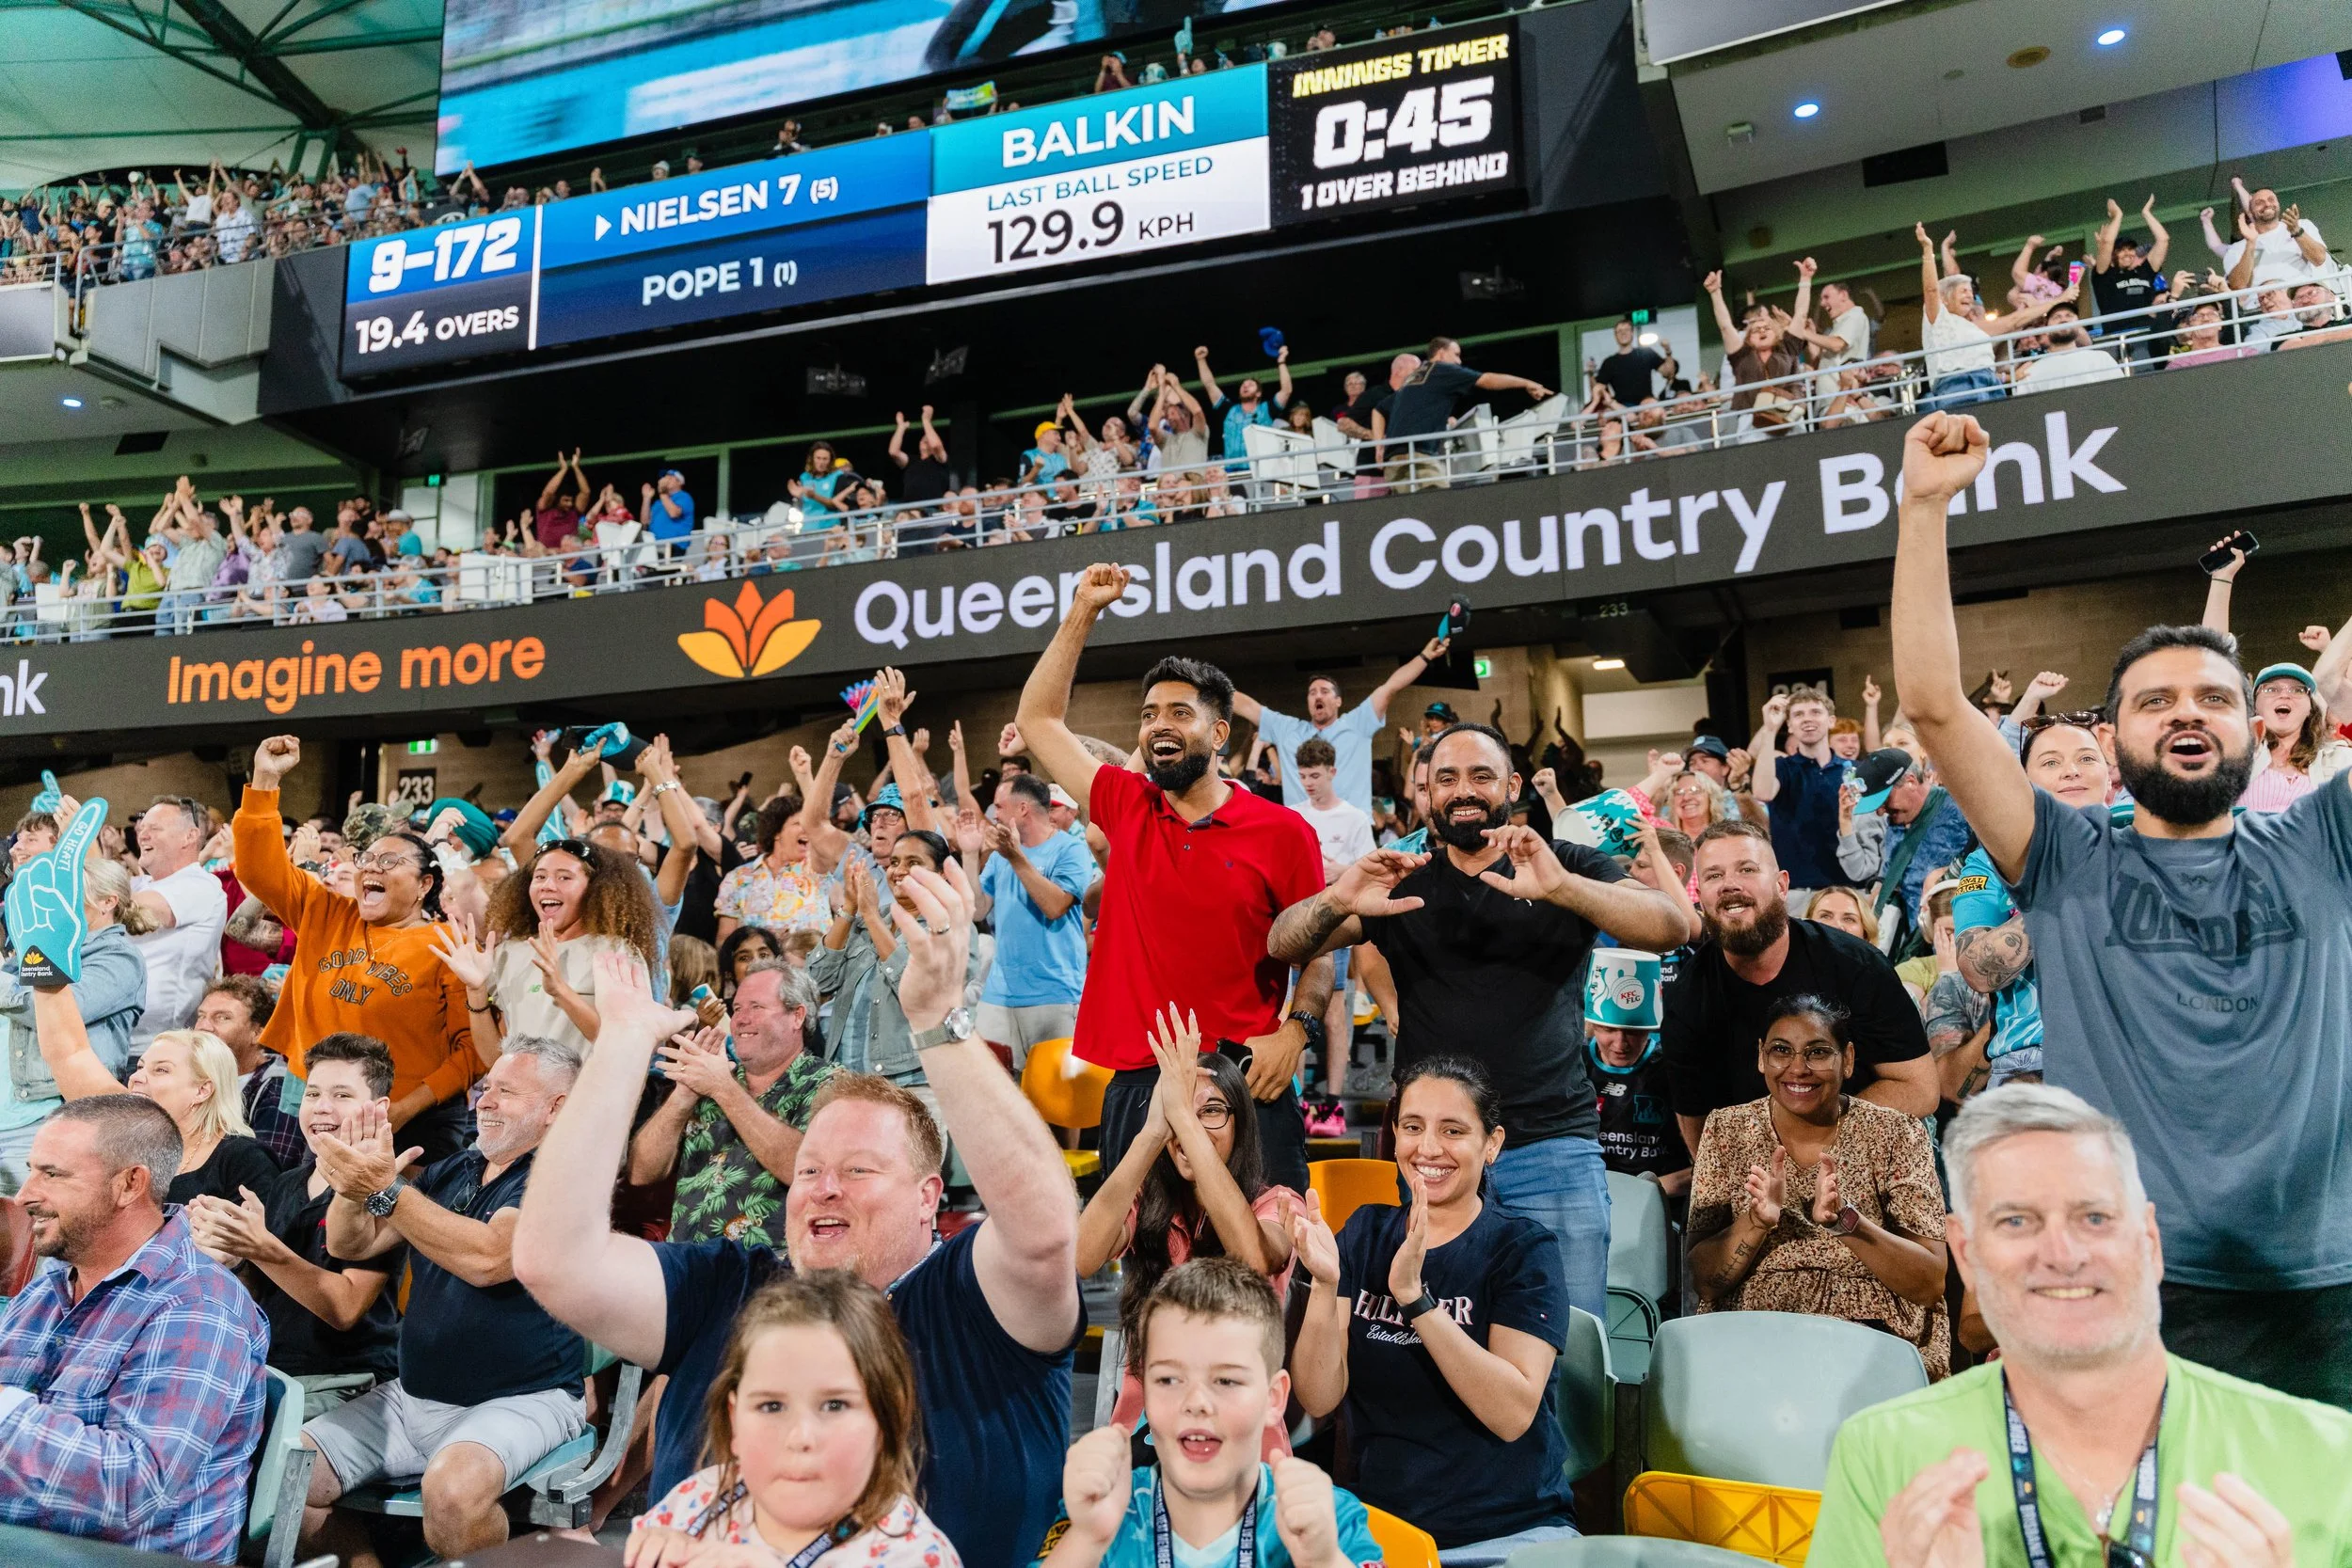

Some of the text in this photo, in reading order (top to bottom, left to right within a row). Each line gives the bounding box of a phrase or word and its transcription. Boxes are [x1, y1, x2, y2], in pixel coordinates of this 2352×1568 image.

[1293, 34, 1509, 98] INNINGS TIMER
[1001, 96, 1195, 168] BALKIN
[1312, 76, 1494, 169] 0:45
[620, 173, 839, 236] NIELSEN 7 (5)
[988, 156, 1214, 213] LAST BALL SPEED
[1300, 152, 1508, 211] 1 OVER BEHIND
[369, 217, 520, 293] 9-172
[988, 199, 1194, 264] 129.9 KPH
[643, 257, 798, 306] POPE 1 (1)
[356, 305, 520, 355] 19.4 OVERS
[1370, 481, 1787, 590] Country
[1820, 410, 2127, 534] Bnk
[1599, 602, 1629, 618] 233
[167, 636, 546, 715] Imagine more
[399, 775, 435, 805] 233
[74, 820, 88, 836] GO
[318, 948, 413, 996] GOOD VIBES
[329, 978, 374, 1006] ONLY
[1620, 990, 1637, 1000] KFC
[2176, 992, 2261, 1013] LONDON
